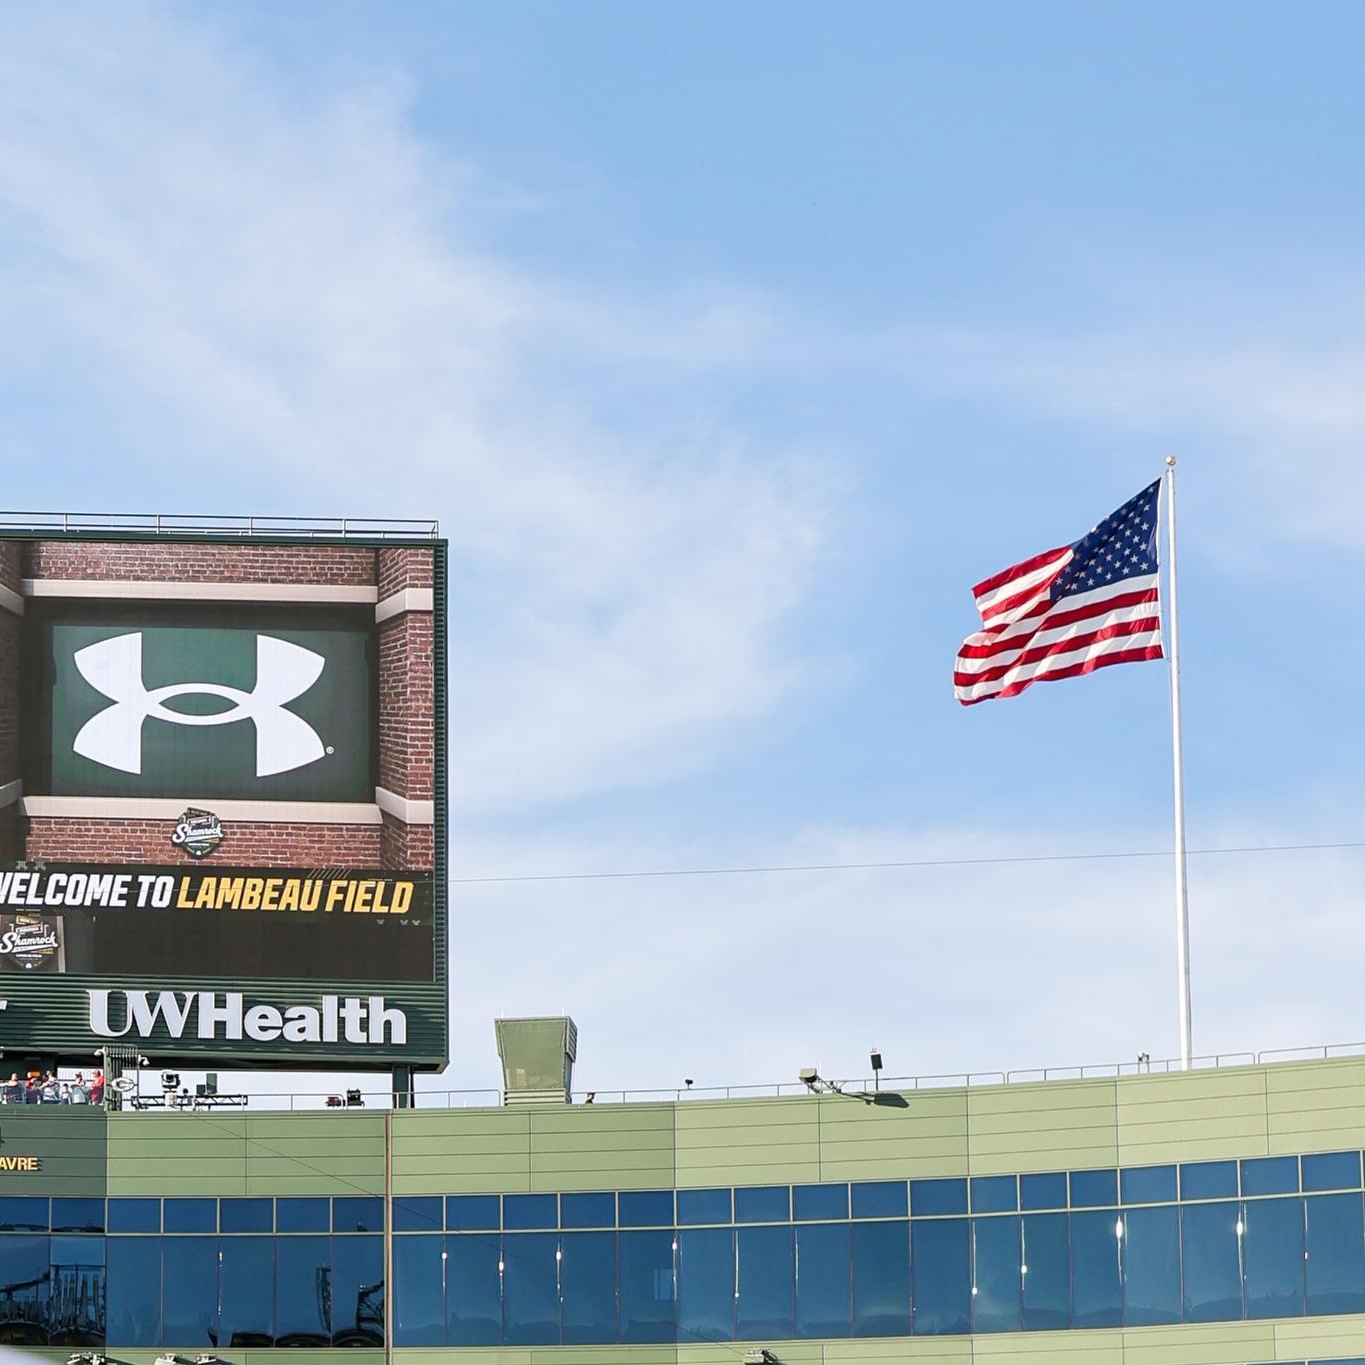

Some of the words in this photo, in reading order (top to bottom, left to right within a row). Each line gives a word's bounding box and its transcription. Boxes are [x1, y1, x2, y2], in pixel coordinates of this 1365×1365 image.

[137, 876, 176, 909] TO
[176, 876, 321, 913] LAMBEAU
[325, 879, 415, 915] FIELD
